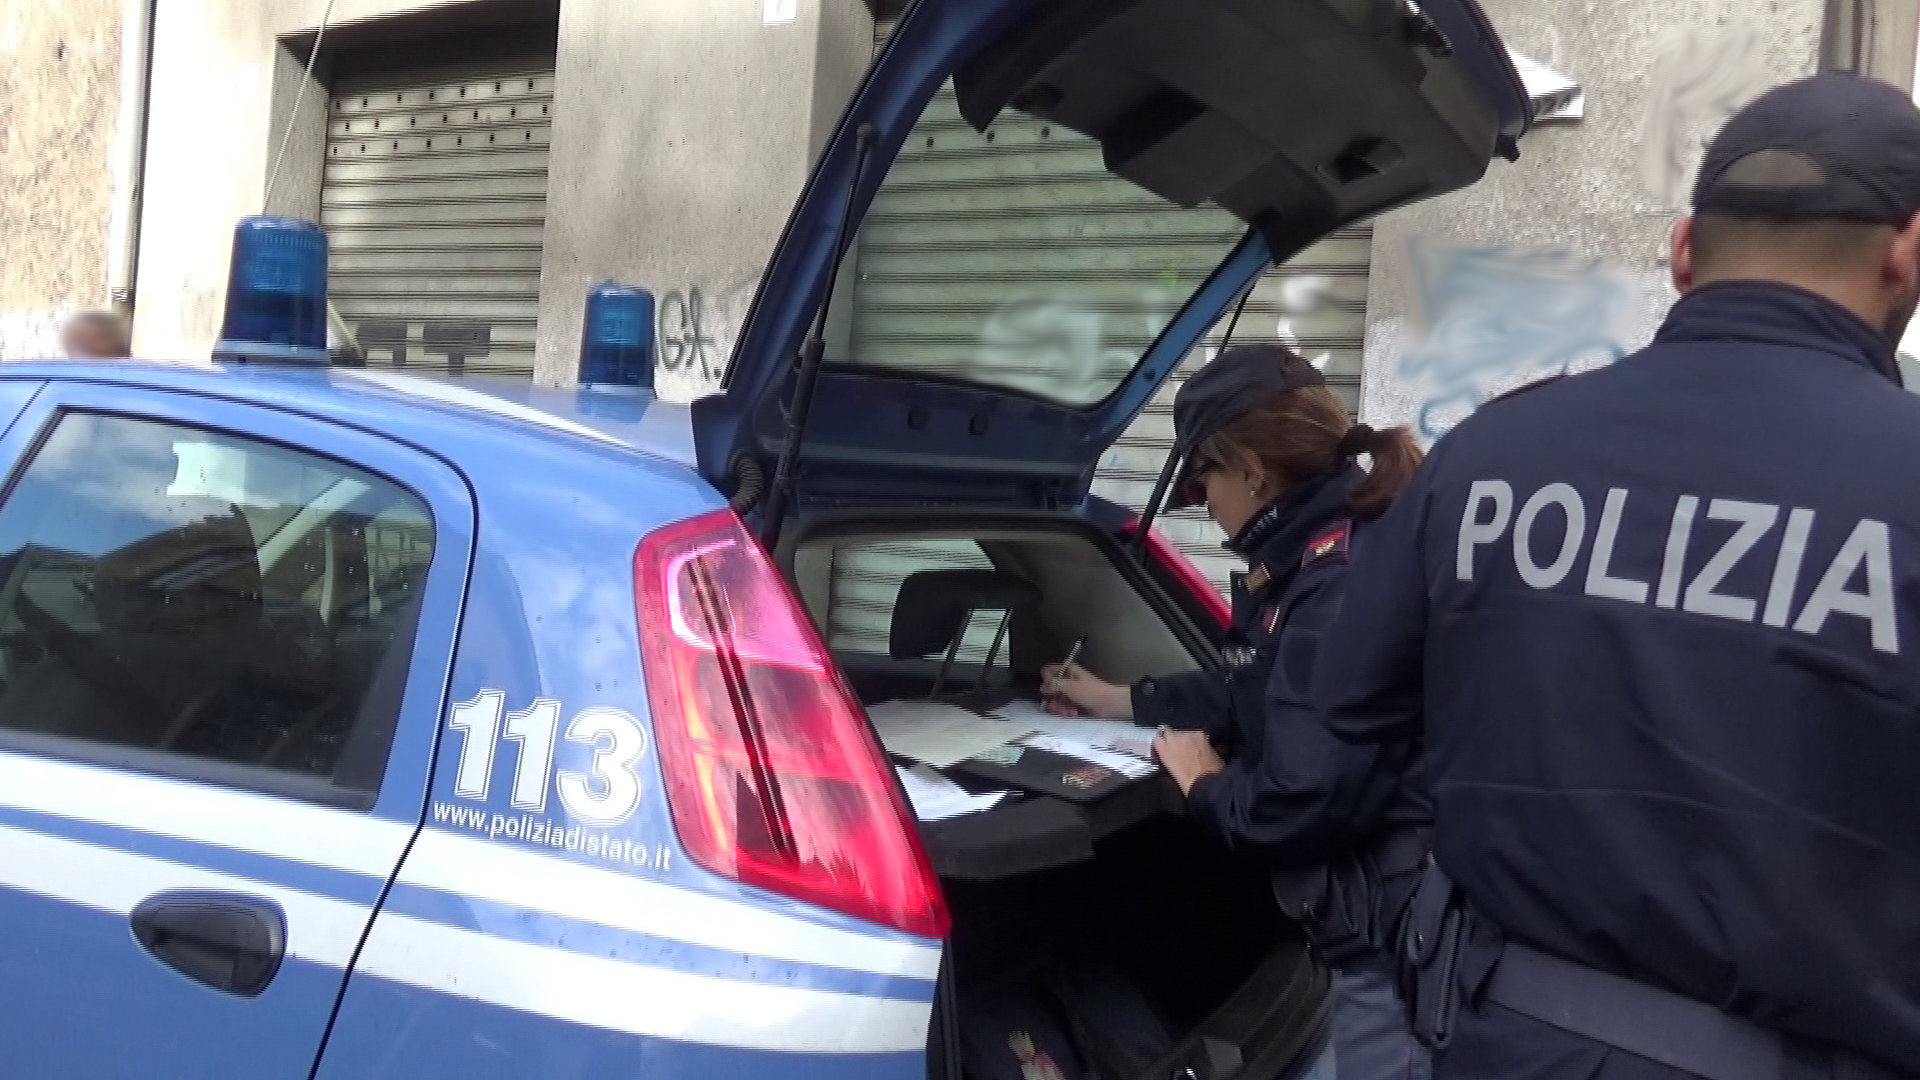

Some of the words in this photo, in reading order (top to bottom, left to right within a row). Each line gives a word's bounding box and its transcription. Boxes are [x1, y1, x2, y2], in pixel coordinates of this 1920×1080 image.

[1456, 479, 1900, 655] POLIZIA
[449, 687, 648, 827] 113
[433, 801, 672, 872] www.poliziadistato.it
